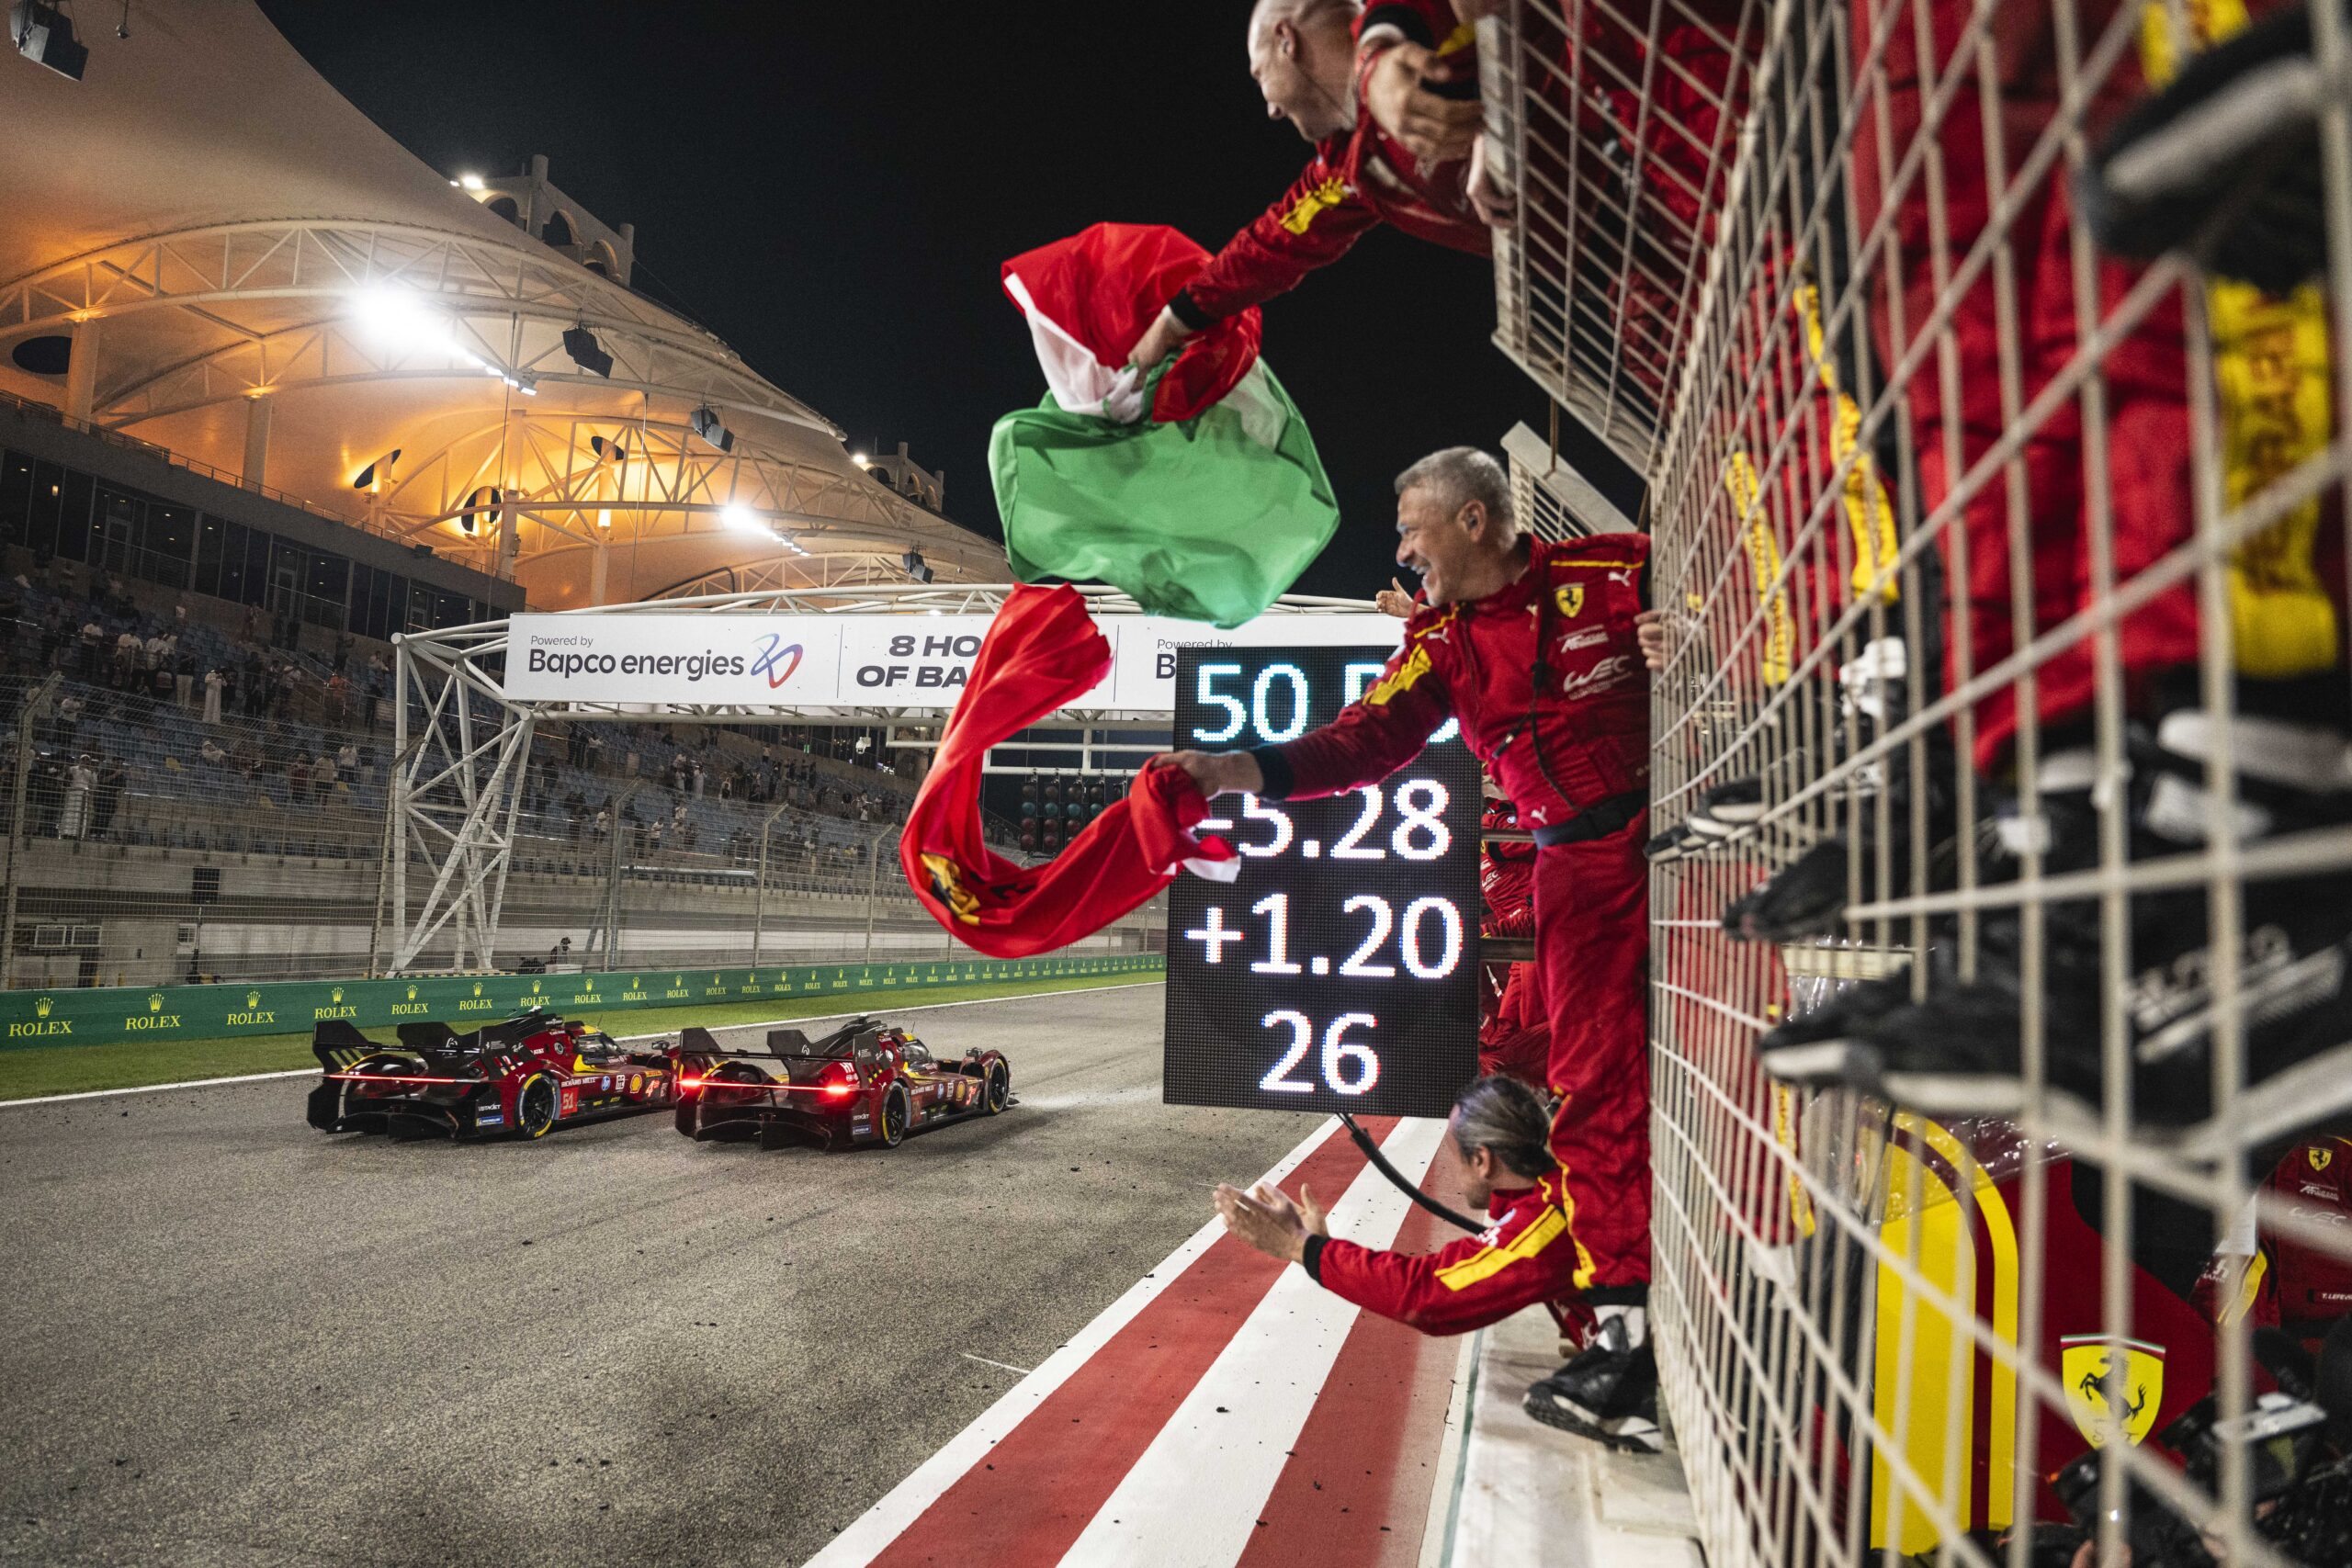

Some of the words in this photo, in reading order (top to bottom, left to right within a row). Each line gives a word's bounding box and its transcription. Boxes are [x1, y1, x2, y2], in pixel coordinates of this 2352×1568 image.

[531, 636, 578, 647] Powered
[580, 636, 594, 649] by
[888, 636, 916, 658] 8
[1158, 638, 1213, 649] Powered
[528, 649, 616, 679] Bapco
[620, 649, 745, 682] energies
[855, 665, 910, 688] OF
[1193, 663, 1309, 742] 50
[1183, 893, 1464, 980] +1.20
[741, 985, 761, 994] ROLEX
[775, 984, 792, 992] ROLEX
[805, 982, 821, 990] ROLEX
[832, 980, 848, 988] ROLEX
[623, 991, 648, 1001] ROLEX
[667, 988, 689, 998] ROLEX
[706, 987, 727, 996] ROLEX
[459, 998, 492, 1010] ROLEX
[520, 996, 550, 1007] ROLEX
[574, 994, 602, 1003] ROLEX
[314, 1006, 357, 1019] ROLEX
[391, 1003, 429, 1015] ROLEX
[125, 1015, 181, 1030] ROLEX
[227, 1011, 276, 1025] ROLEX
[8, 1021, 73, 1037] ROLEX
[1259, 1010, 1381, 1096] 26
[562, 1092, 574, 1111] 51
